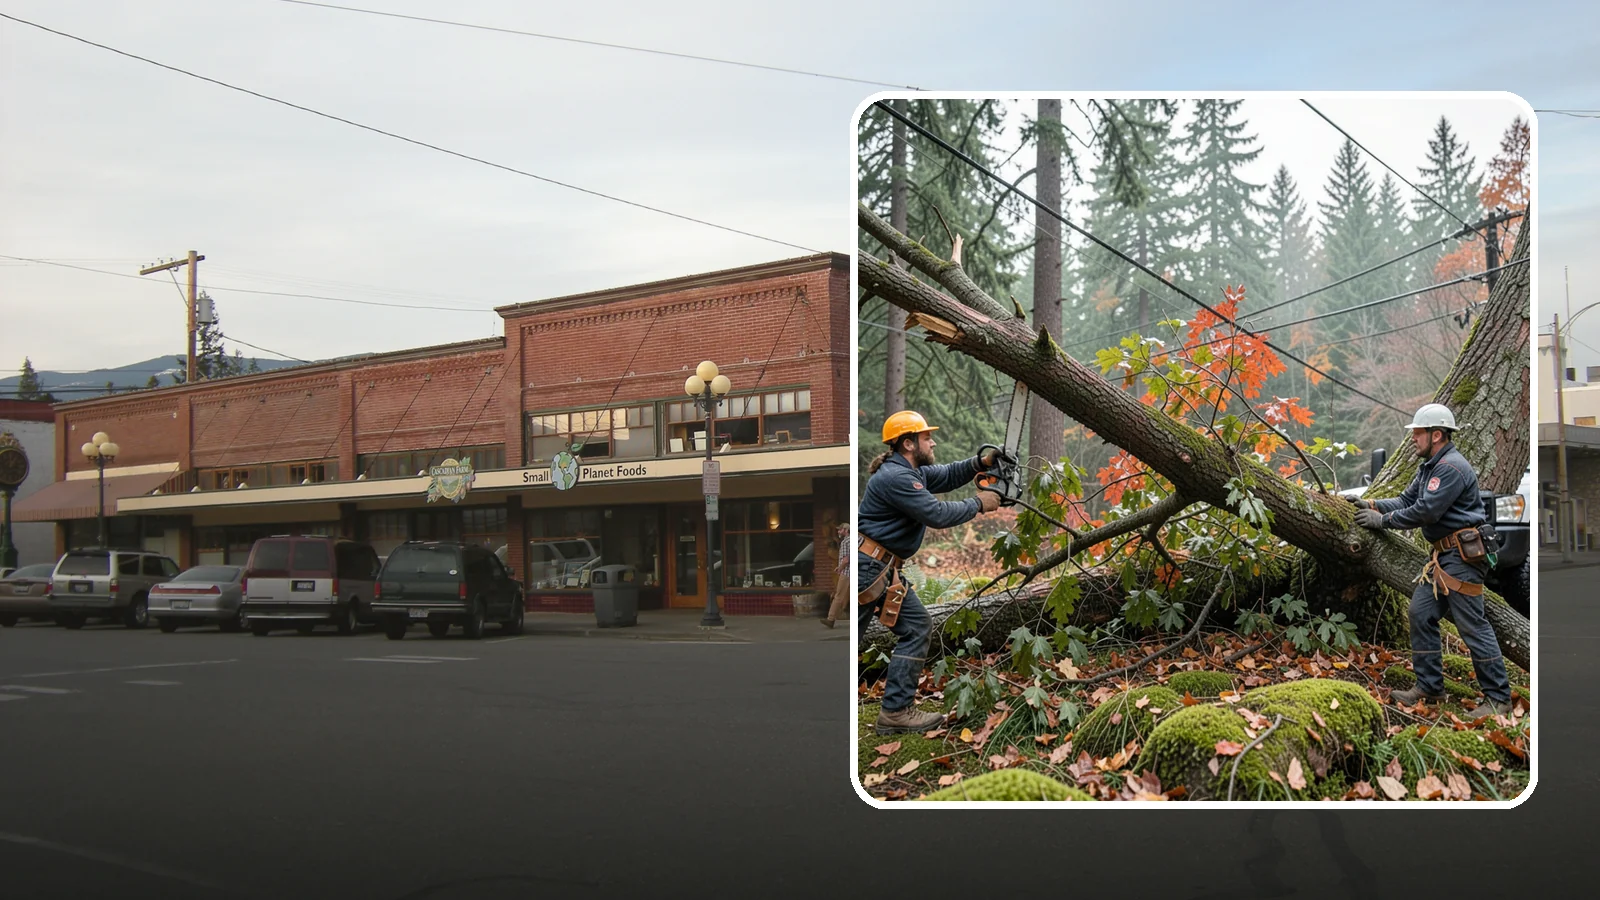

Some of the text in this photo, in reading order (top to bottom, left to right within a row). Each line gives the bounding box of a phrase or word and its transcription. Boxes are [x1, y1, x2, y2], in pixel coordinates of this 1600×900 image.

[523, 464, 647, 483] Small Planet Foods
